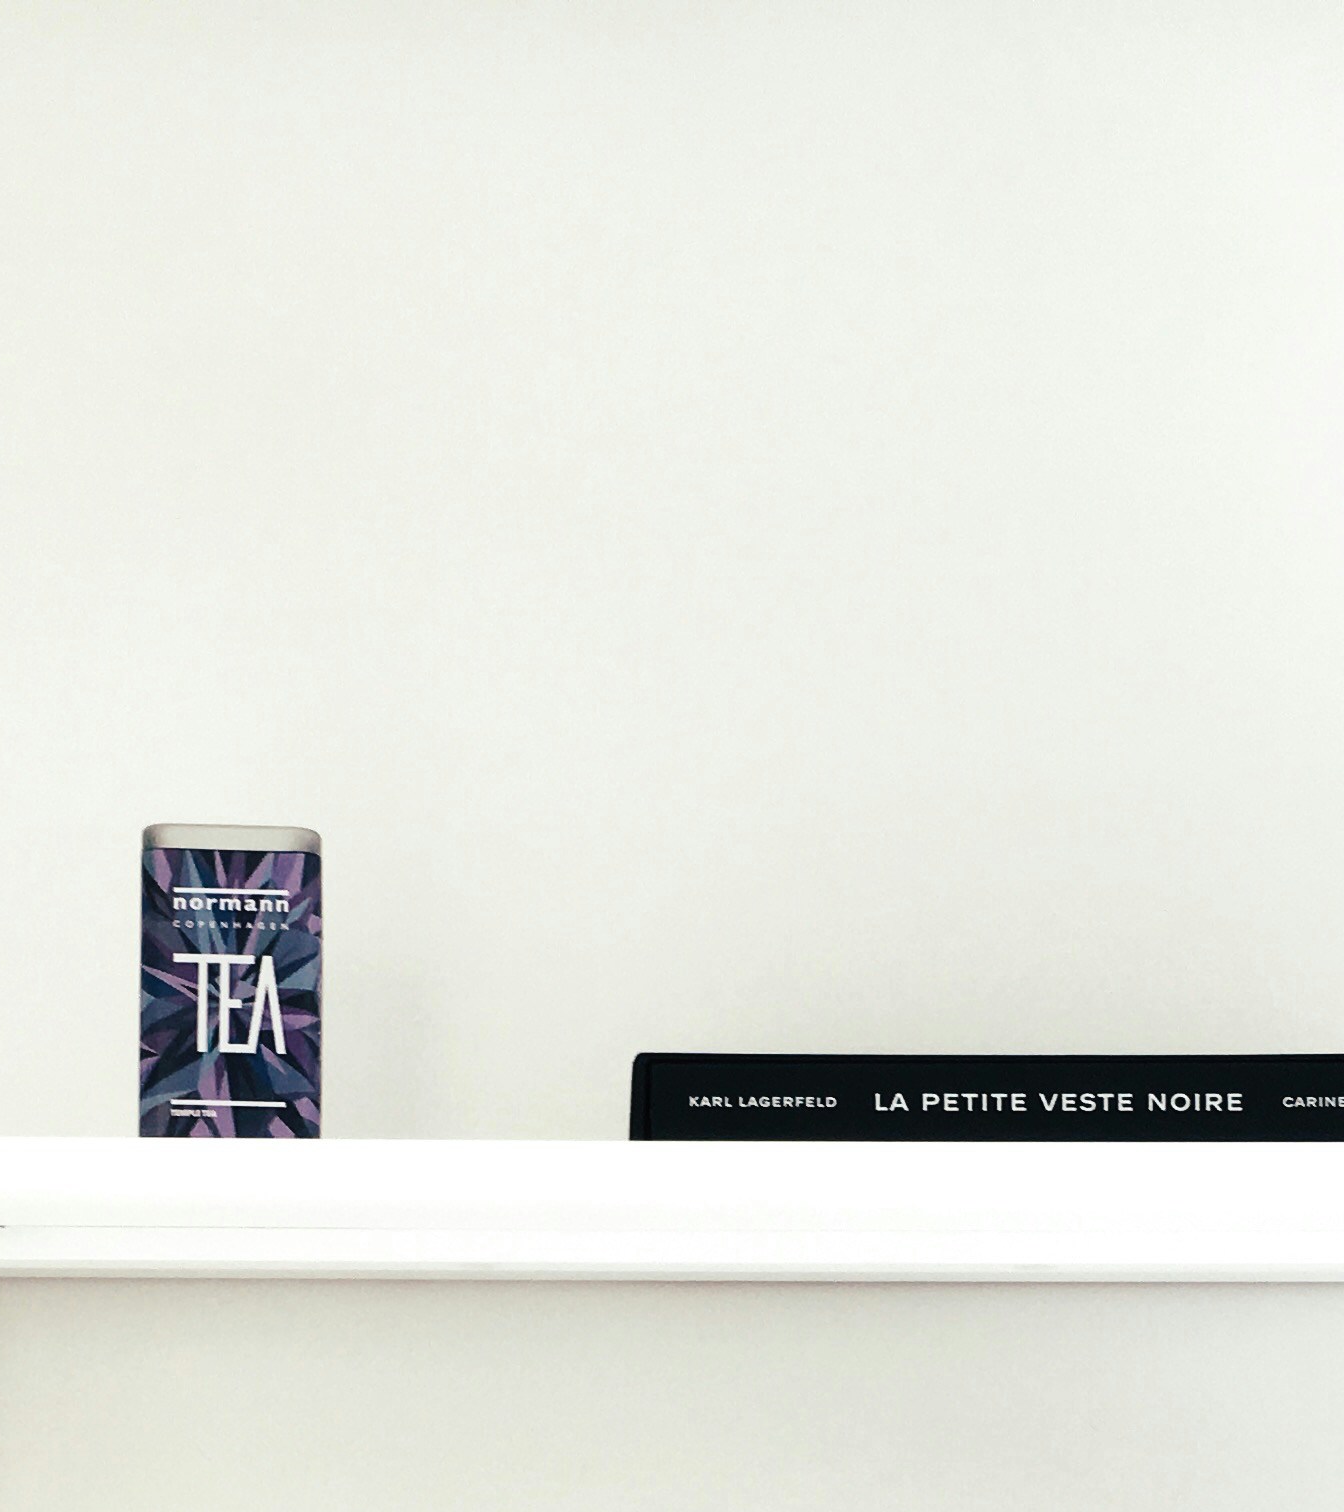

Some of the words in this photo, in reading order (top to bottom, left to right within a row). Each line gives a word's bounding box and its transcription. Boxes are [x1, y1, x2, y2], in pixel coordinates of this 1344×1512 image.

[173, 896, 290, 914] normann
[172, 920, 290, 931] COPENHAGEN
[173, 953, 287, 1055] TEA
[689, 1096, 732, 1107] KARL
[739, 1096, 837, 1108] LAGERFELD
[874, 1093, 909, 1111] LA
[921, 1093, 1028, 1112] PETITE
[1040, 1093, 1134, 1112] VESTE
[1147, 1093, 1243, 1112] NOIRE
